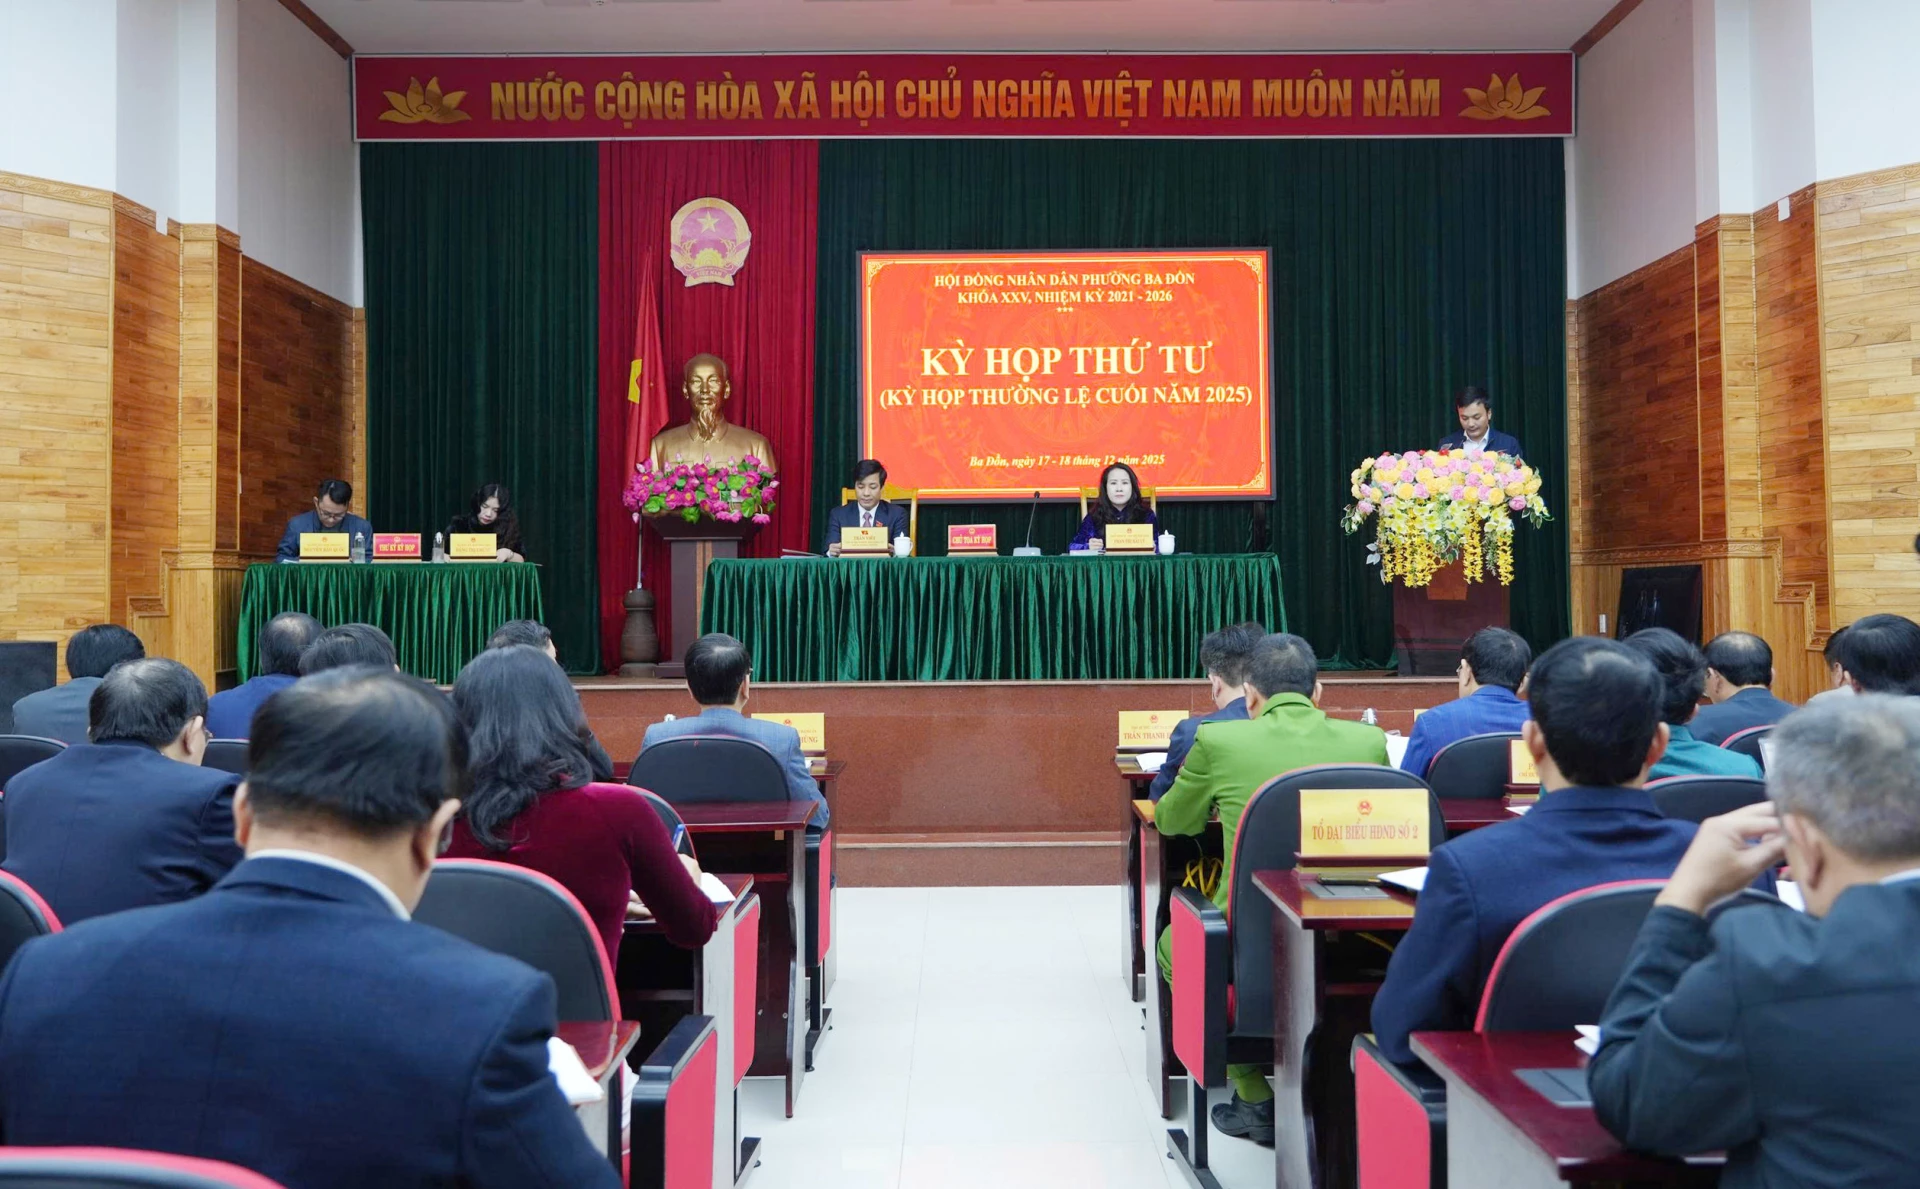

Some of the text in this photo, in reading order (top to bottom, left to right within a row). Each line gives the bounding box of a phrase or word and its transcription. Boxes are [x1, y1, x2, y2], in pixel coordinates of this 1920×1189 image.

[490, 66, 1440, 130] NƯỚC CỘNG HÒA XÃ HỘI CHỦ NGHĨA VIỆT NAM MUÔN NĂM
[934, 269, 1195, 290] HỘI ĐỒNG NHÂN DÂN PHƯỜNG BA ĐỒN
[957, 289, 999, 304] KHÓA
[1001, 291, 1033, 305] XXV,
[1034, 289, 1081, 306] NHIỆM
[1085, 288, 1105, 303] KỲ
[1107, 291, 1134, 303] 2021
[1145, 290, 1173, 302] 2026
[920, 337, 1213, 383] KỲ HỌP THỨ TƯ
[879, 382, 1253, 410] (KỲ HỌP THƯỜNG LỆ CUỐI NĂM 2025)
[969, 455, 983, 467] Ba
[1011, 456, 1036, 468] ngày
[1038, 455, 1051, 466] 17
[1059, 455, 1071, 466] 18
[1073, 455, 1101, 468] tháng
[1103, 455, 1115, 465] 12
[1141, 454, 1165, 465] 2025
[1143, 732, 1166, 740] THANH
[1312, 817, 1419, 843] TỔ ĐẠI BIỂU HĐND SỐ 2
